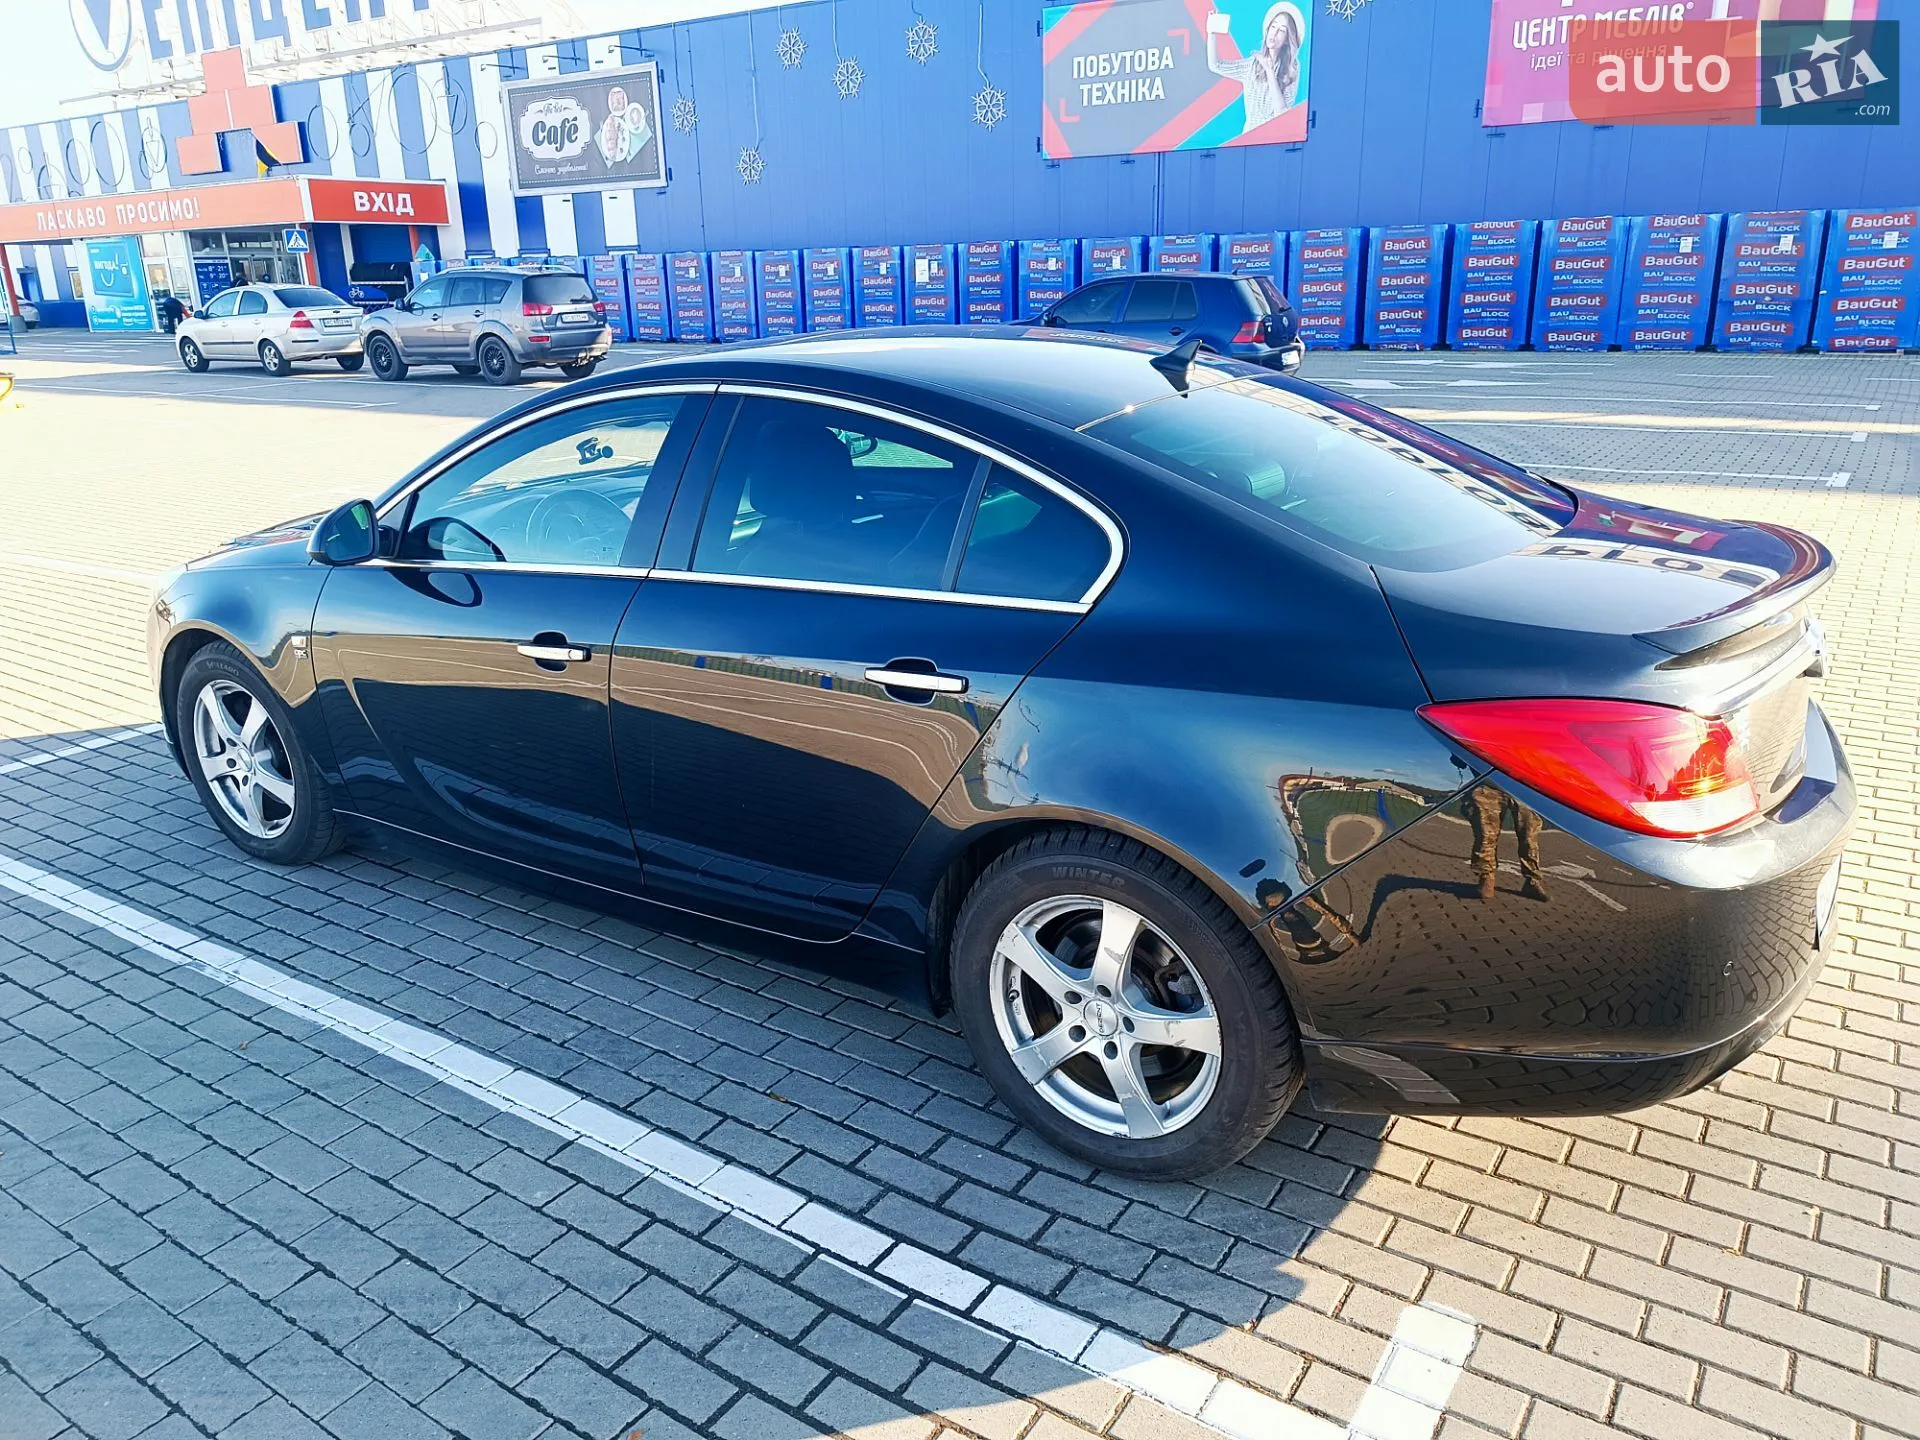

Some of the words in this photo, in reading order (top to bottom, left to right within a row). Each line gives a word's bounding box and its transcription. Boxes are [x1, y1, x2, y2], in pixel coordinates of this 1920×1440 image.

[1512, 14, 1587, 51] ЦЕНТР
[1073, 46, 1174, 79] ПОБУТОВА
[1531, 51, 1563, 71] ідеї
[1568, 53, 1586, 64] та
[1080, 77, 1165, 107] ТЕХНІКА
[532, 116, 579, 152] Café
[353, 191, 415, 216] ВХІД
[36, 206, 106, 231] ЛАСКАВО
[115, 196, 200, 225] ПРОСИМО!
[1562, 220, 1606, 231] BauGut
[1654, 216, 1699, 227] BauGut
[1851, 215, 1910, 228] BauGut
[970, 245, 997, 253] BauGut
[1233, 244, 1270, 254] BauGut
[1385, 240, 1426, 250] BauGut
[864, 248, 888, 257] BauGut
[1094, 248, 1125, 258] BauGut
[1304, 249, 1343, 258] BauGut
[1162, 255, 1197, 263] BauGut
[1468, 256, 1514, 267] BauGut
[1645, 256, 1698, 266] BauGut
[1844, 258, 1905, 270] BauGut
[1555, 259, 1604, 270] BauGut
[864, 277, 892, 285] BauGut
[969, 275, 1001, 283] BauGut
[1381, 276, 1424, 285] BauGut
[814, 289, 840, 297] BauGut
[1303, 283, 1342, 293] BauGut
[1735, 284, 1794, 295] BauGut
[1030, 291, 1062, 299] BauGut
[1465, 293, 1511, 303] BauGut
[1640, 294, 1692, 304] BauGut
[915, 298, 944, 306] BauGut
[1551, 296, 1600, 307] BauGut
[1837, 299, 1898, 310] BauGut
[865, 304, 894, 312] BauGut
[970, 304, 1000, 312] BauGut
[815, 315, 841, 323] BauGut
[1380, 311, 1423, 320] BauGut
[1301, 317, 1340, 326] BauGut
[1462, 328, 1507, 338] BauGut
[1730, 323, 1786, 333] BauGut
[1548, 332, 1595, 341] BauGut
[1635, 331, 1687, 341] BauGut
[1835, 338, 1891, 347] BauGut
[1052, 866, 1125, 886] WINTER
